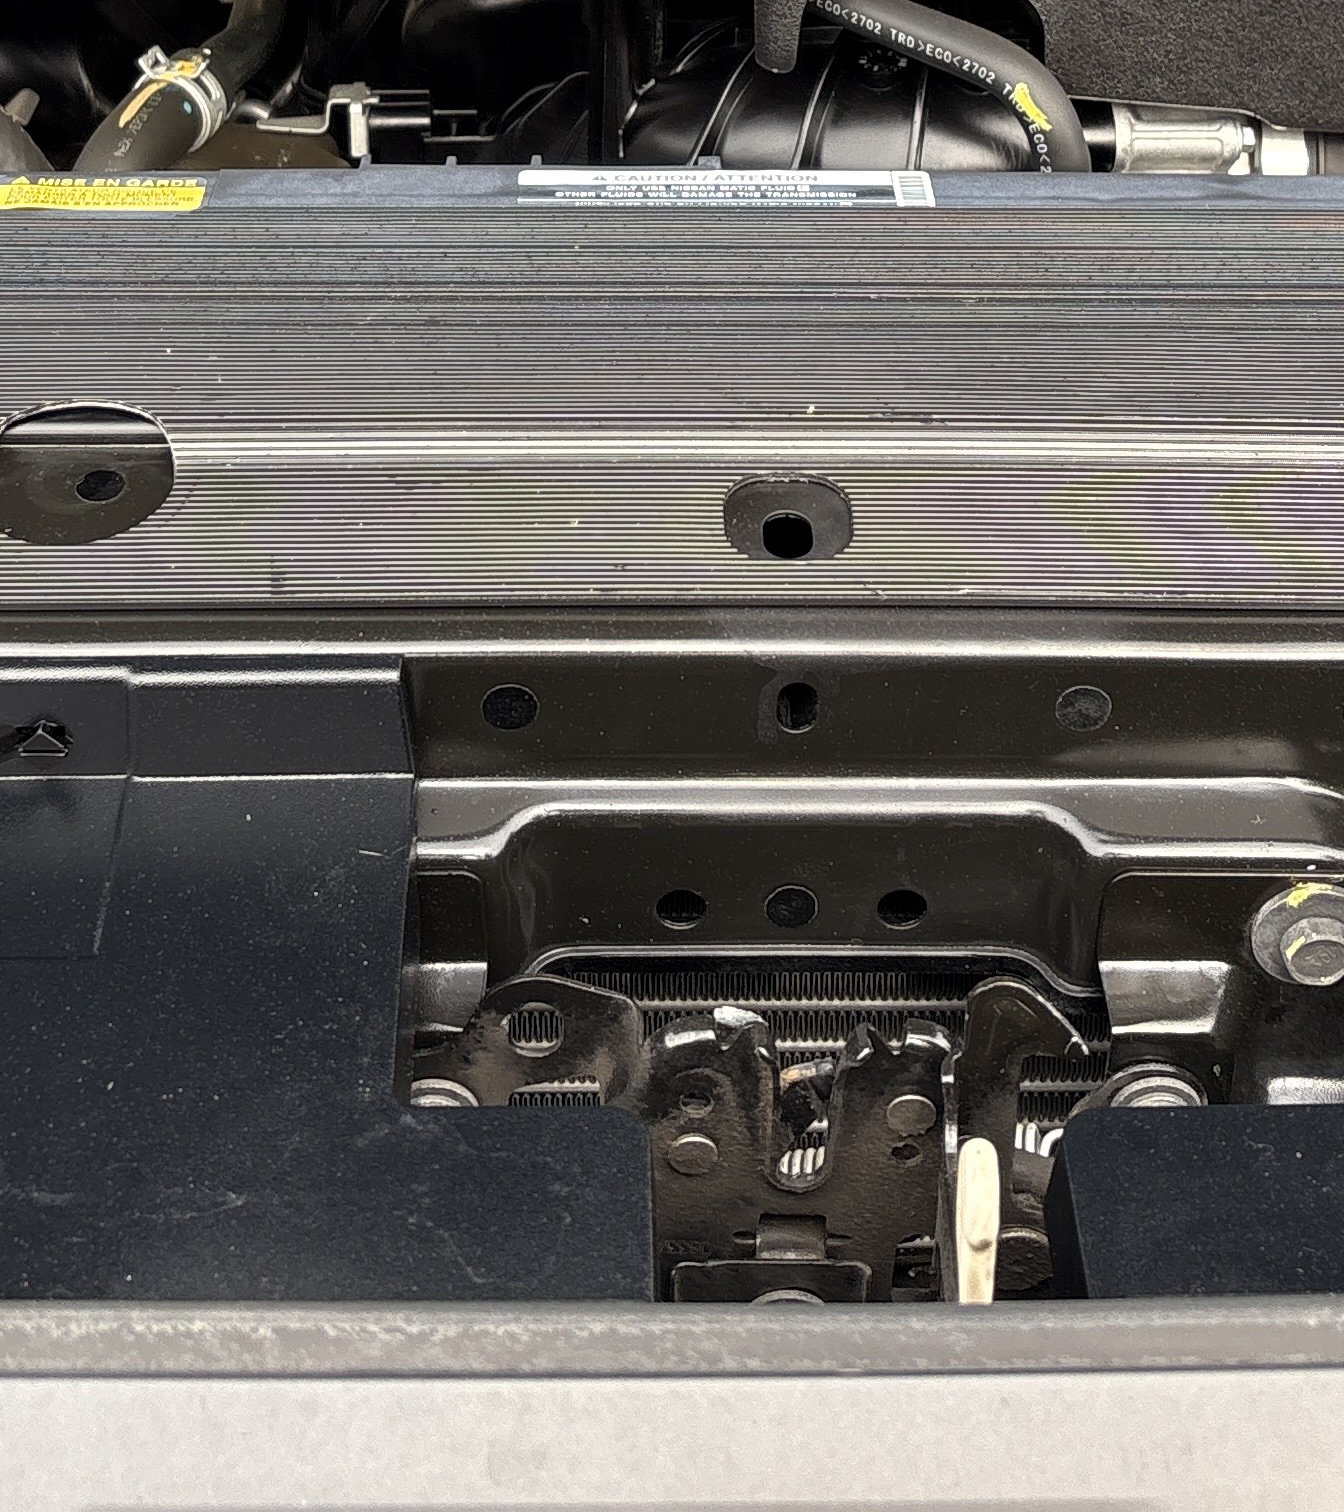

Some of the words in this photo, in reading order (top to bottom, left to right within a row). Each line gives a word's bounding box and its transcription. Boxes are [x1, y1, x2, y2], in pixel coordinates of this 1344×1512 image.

[37, 177, 87, 186] MISE
[93, 178, 121, 186] EN
[126, 178, 197, 187] GARDE
[714, 174, 818, 182] ATTENTION
